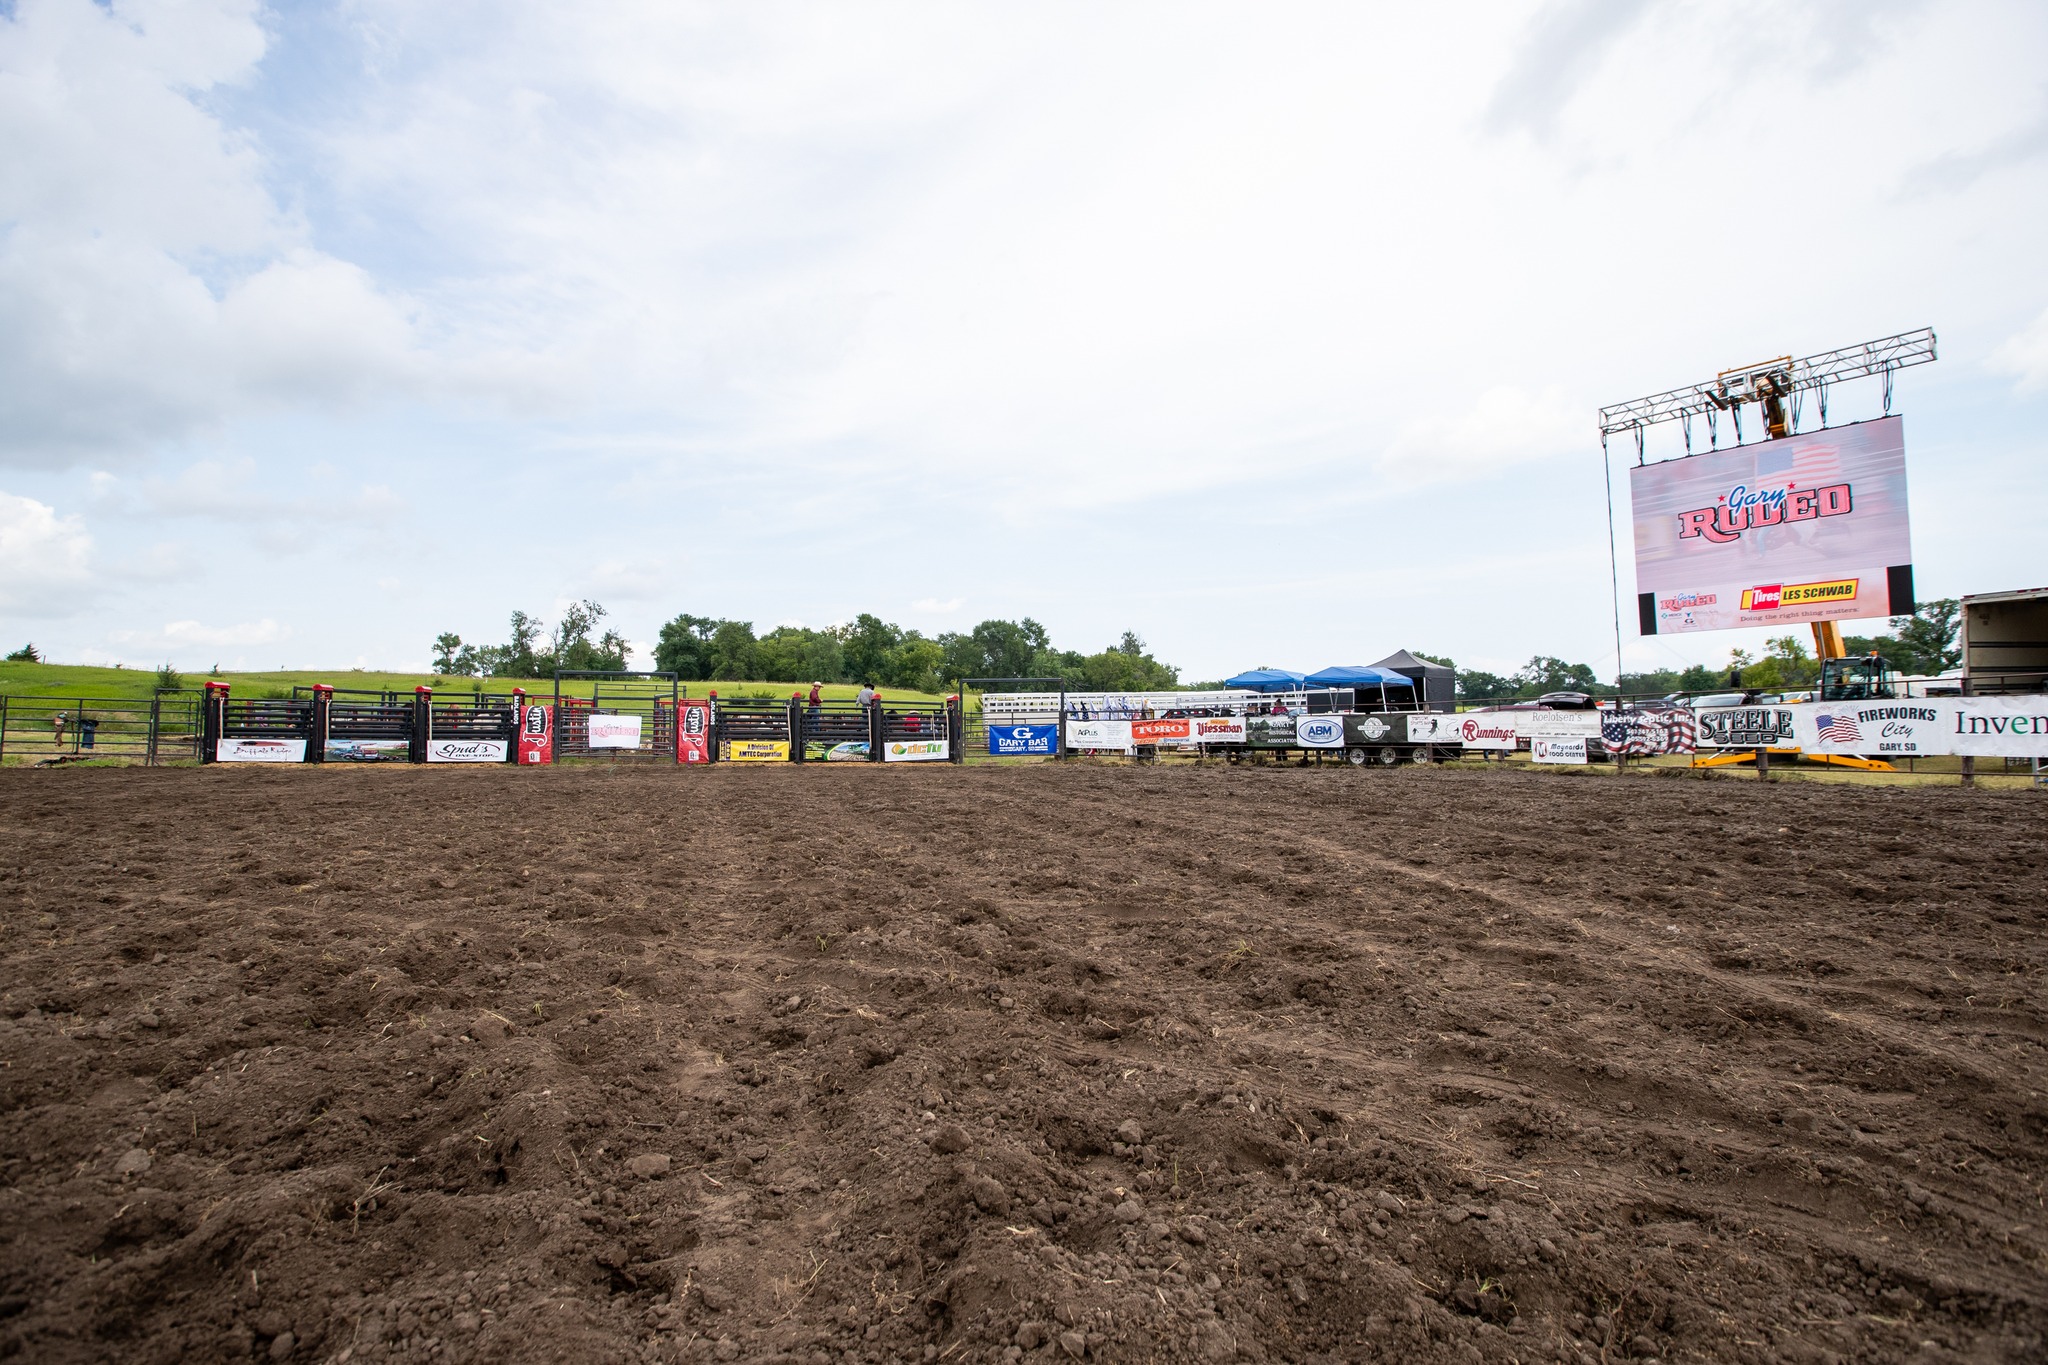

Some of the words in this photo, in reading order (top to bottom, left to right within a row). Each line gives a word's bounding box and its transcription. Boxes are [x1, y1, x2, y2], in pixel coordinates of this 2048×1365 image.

[1727, 484, 1787, 514] Gary
[1678, 484, 1853, 543] RODEO
[1752, 586, 1781, 605] Tires
[1783, 588, 1800, 601] LES
[1803, 585, 1853, 600] SCHWAB
[1603, 714, 1637, 725] Liberty
[1637, 715, 1672, 725] Septic,
[1674, 713, 1693, 722] Inc.
[1858, 706, 1937, 723] FIREWORKS
[523, 706, 548, 747] Justin
[682, 707, 704, 746] Justin
[1136, 725, 1184, 734] TORO
[1308, 725, 1332, 736] ABM
[1462, 719, 1515, 742] Runnings
[1699, 708, 1794, 740] STEELE
[1881, 721, 1913, 738] City
[1955, 711, 2048, 735] Inven
[1012, 727, 1034, 739] G
[1713, 732, 1778, 744] SEED
[440, 743, 488, 757] Spud's
[999, 738, 1026, 747] GARY
[1028, 737, 1048, 746] BAR
[1550, 743, 1584, 751] Maynards
[1904, 742, 1917, 751] SD
